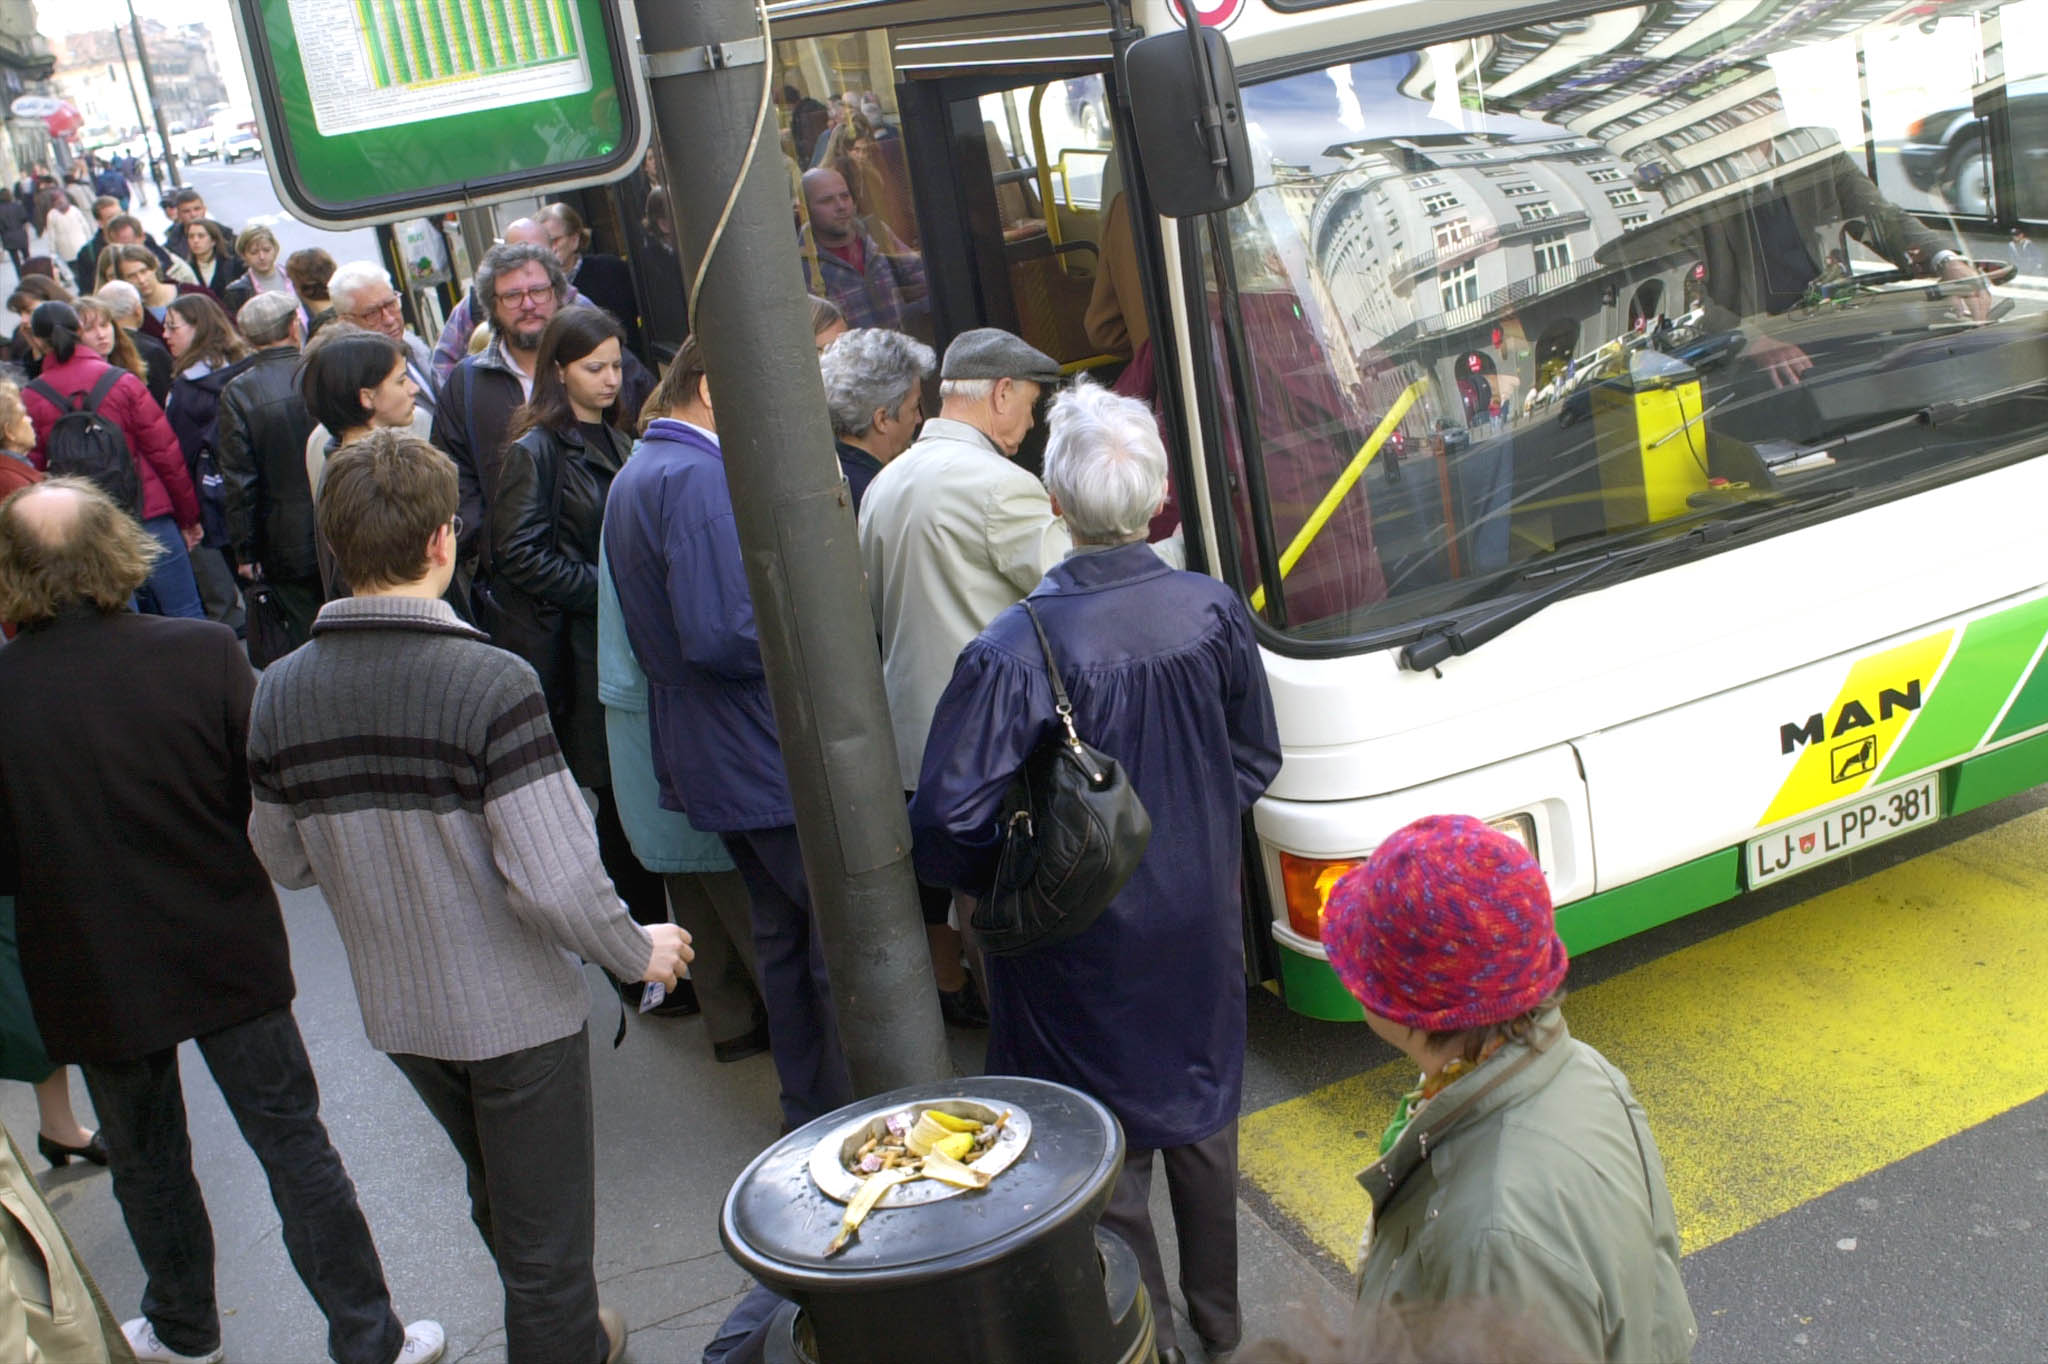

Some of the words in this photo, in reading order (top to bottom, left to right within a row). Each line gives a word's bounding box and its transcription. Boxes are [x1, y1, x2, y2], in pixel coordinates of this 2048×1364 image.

[1780, 679, 1921, 755] MAN
[1758, 835, 1792, 876] LJ
[1823, 784, 1931, 851] LPP-381
